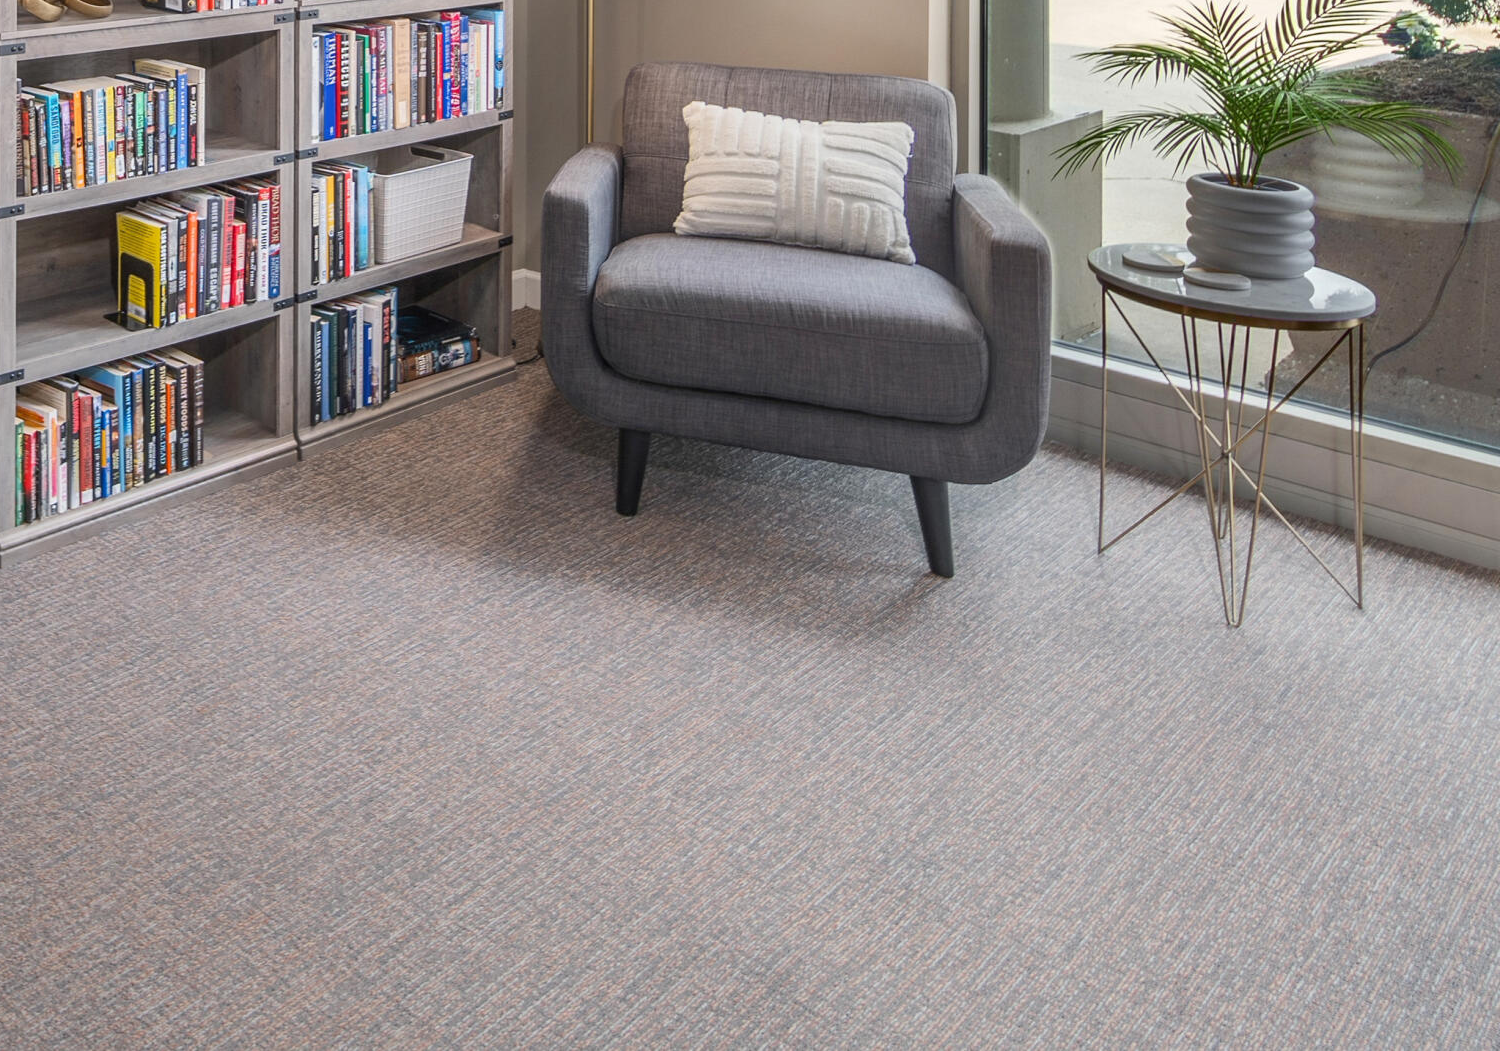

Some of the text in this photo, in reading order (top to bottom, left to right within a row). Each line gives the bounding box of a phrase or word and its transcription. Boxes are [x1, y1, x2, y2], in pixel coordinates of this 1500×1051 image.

[341, 40, 349, 87] FLEECED
[51, 106, 60, 144] SANDFORD
[270, 188, 279, 243] BRAD THOR
